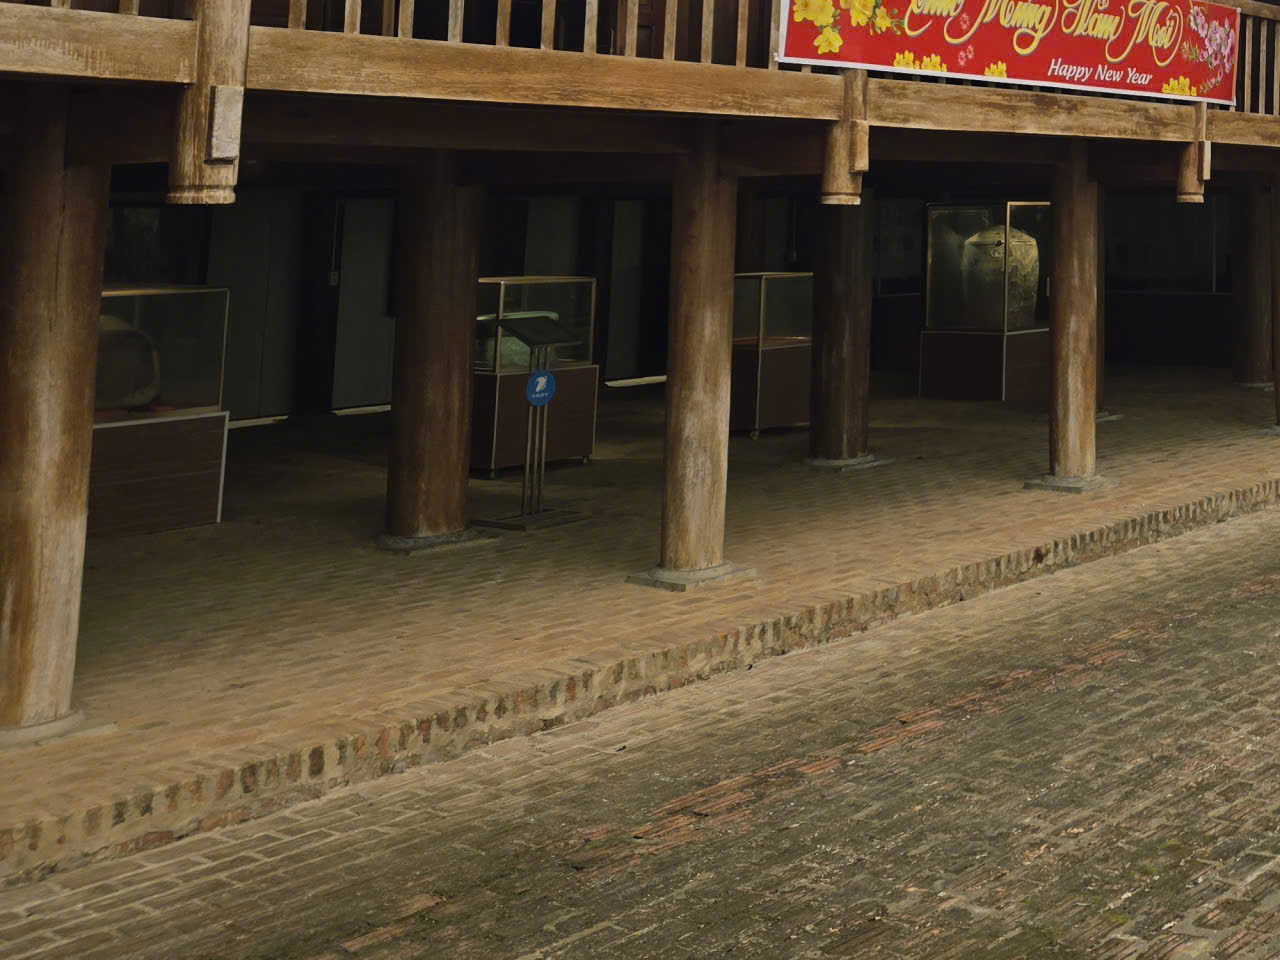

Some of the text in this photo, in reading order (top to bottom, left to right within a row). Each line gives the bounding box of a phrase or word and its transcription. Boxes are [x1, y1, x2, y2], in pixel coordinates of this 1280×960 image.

[1048, 58, 1153, 85] Happy New Year
